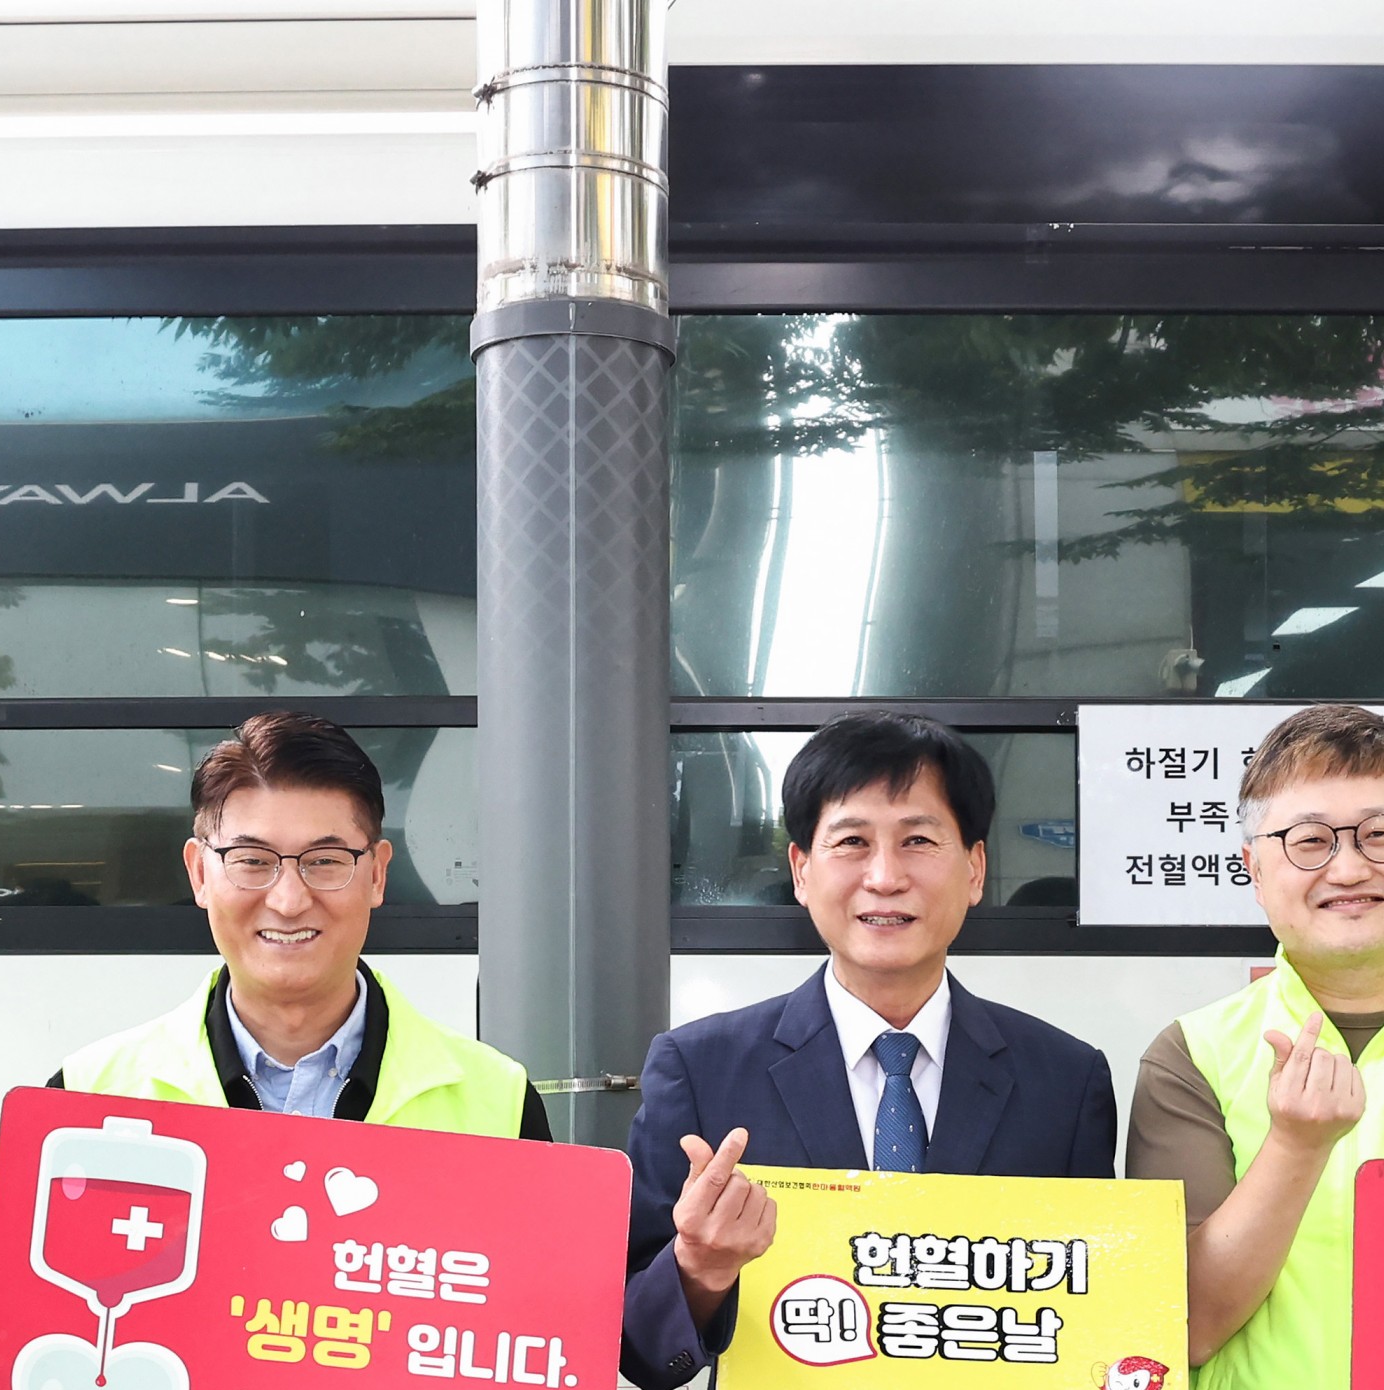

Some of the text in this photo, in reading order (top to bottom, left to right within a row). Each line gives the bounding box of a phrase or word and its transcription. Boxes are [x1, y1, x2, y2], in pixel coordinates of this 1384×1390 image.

[1125, 747, 1219, 779] 하절기
[1166, 801, 1242, 833] 부족
[332, 1239, 491, 1305] 헌혈은
[849, 1231, 1089, 1295] 헌혈하기
[230, 1294, 579, 1389] '생명' 입니다.
[781, 1297, 1064, 1364] 딱! 좋은날
